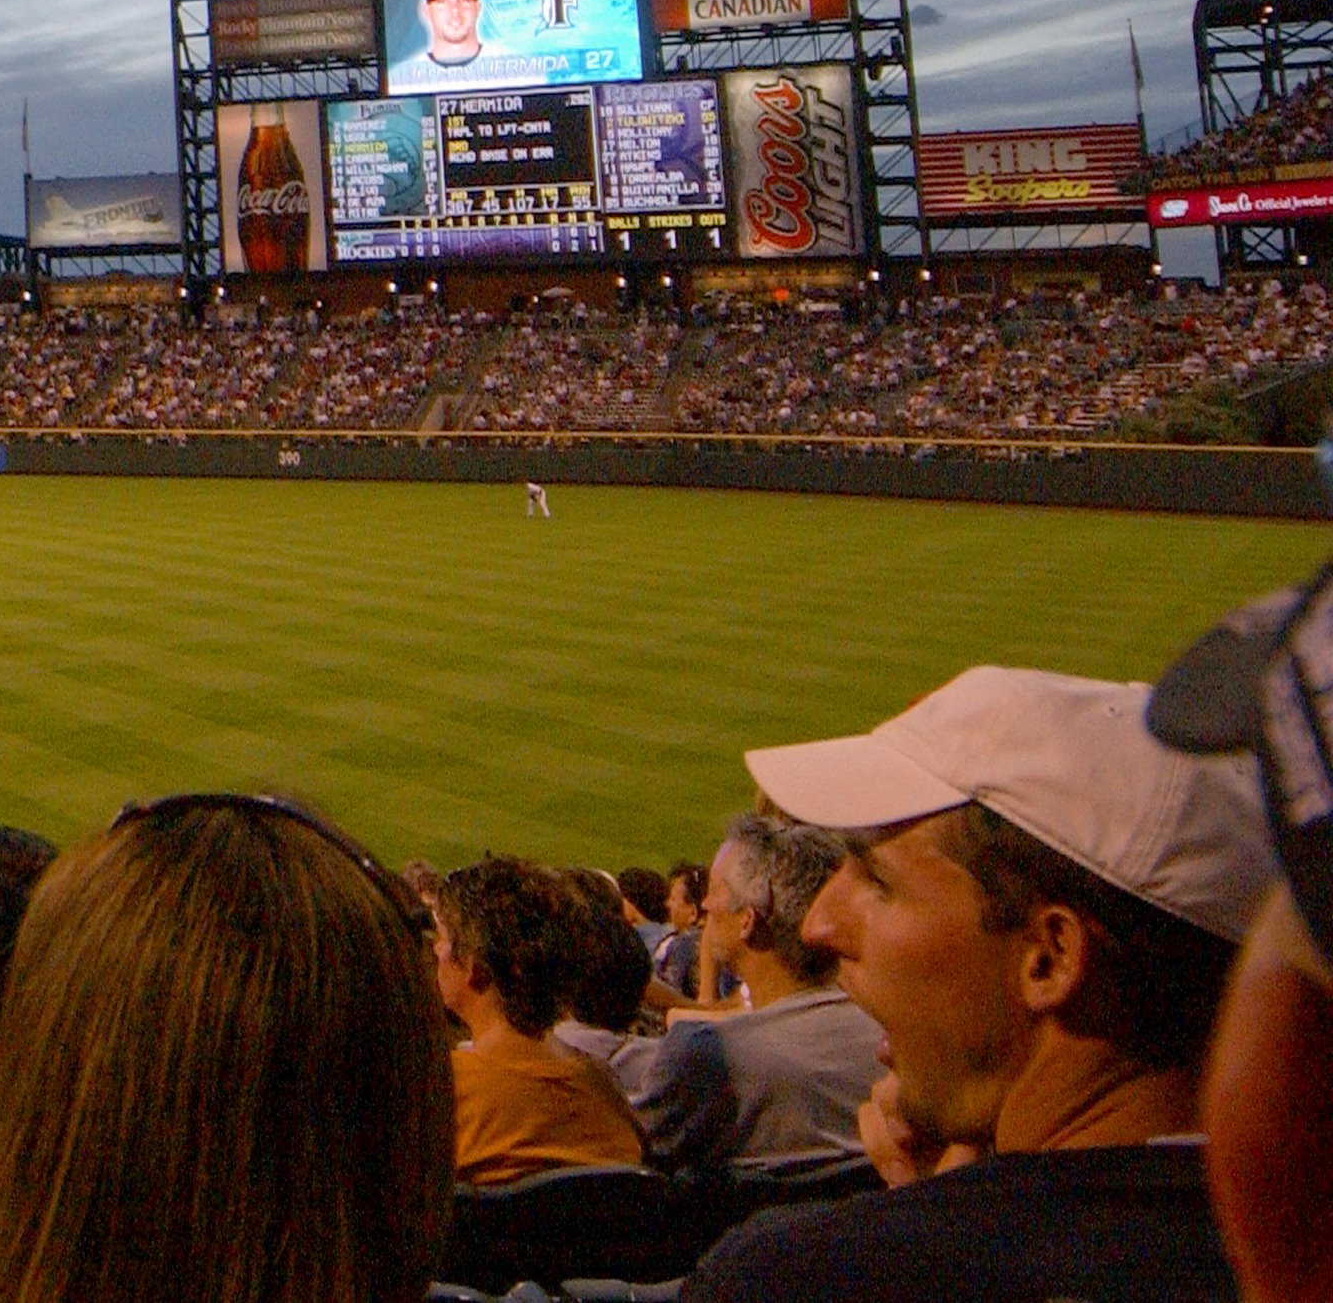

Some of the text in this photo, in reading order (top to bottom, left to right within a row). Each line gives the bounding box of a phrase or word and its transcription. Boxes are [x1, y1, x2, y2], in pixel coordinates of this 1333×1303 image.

[218, 21, 256, 37] Rocky
[585, 50, 614, 70] 27
[440, 96, 523, 116] 27 HERMIDA
[478, 124, 494, 137] TO
[481, 148, 509, 162] BASE
[512, 146, 529, 161] ON
[963, 137, 1088, 176] KING
[345, 162, 409, 175] WILLINGHAM
[744, 76, 817, 253] Coors
[964, 172, 1092, 207] Soopers
[238, 180, 310, 218] Coca-Cola
[507, 197, 535, 212] 107
[541, 195, 560, 210] 17
[1255, 198, 1292, 211] Official
[1292, 195, 1328, 211] Jeweler
[648, 214, 693, 227] STRIKES
[699, 213, 727, 226] OUTS
[619, 227, 721, 251] 1 1 1
[336, 244, 397, 261] ROCKIES
[278, 451, 301, 466] 390
